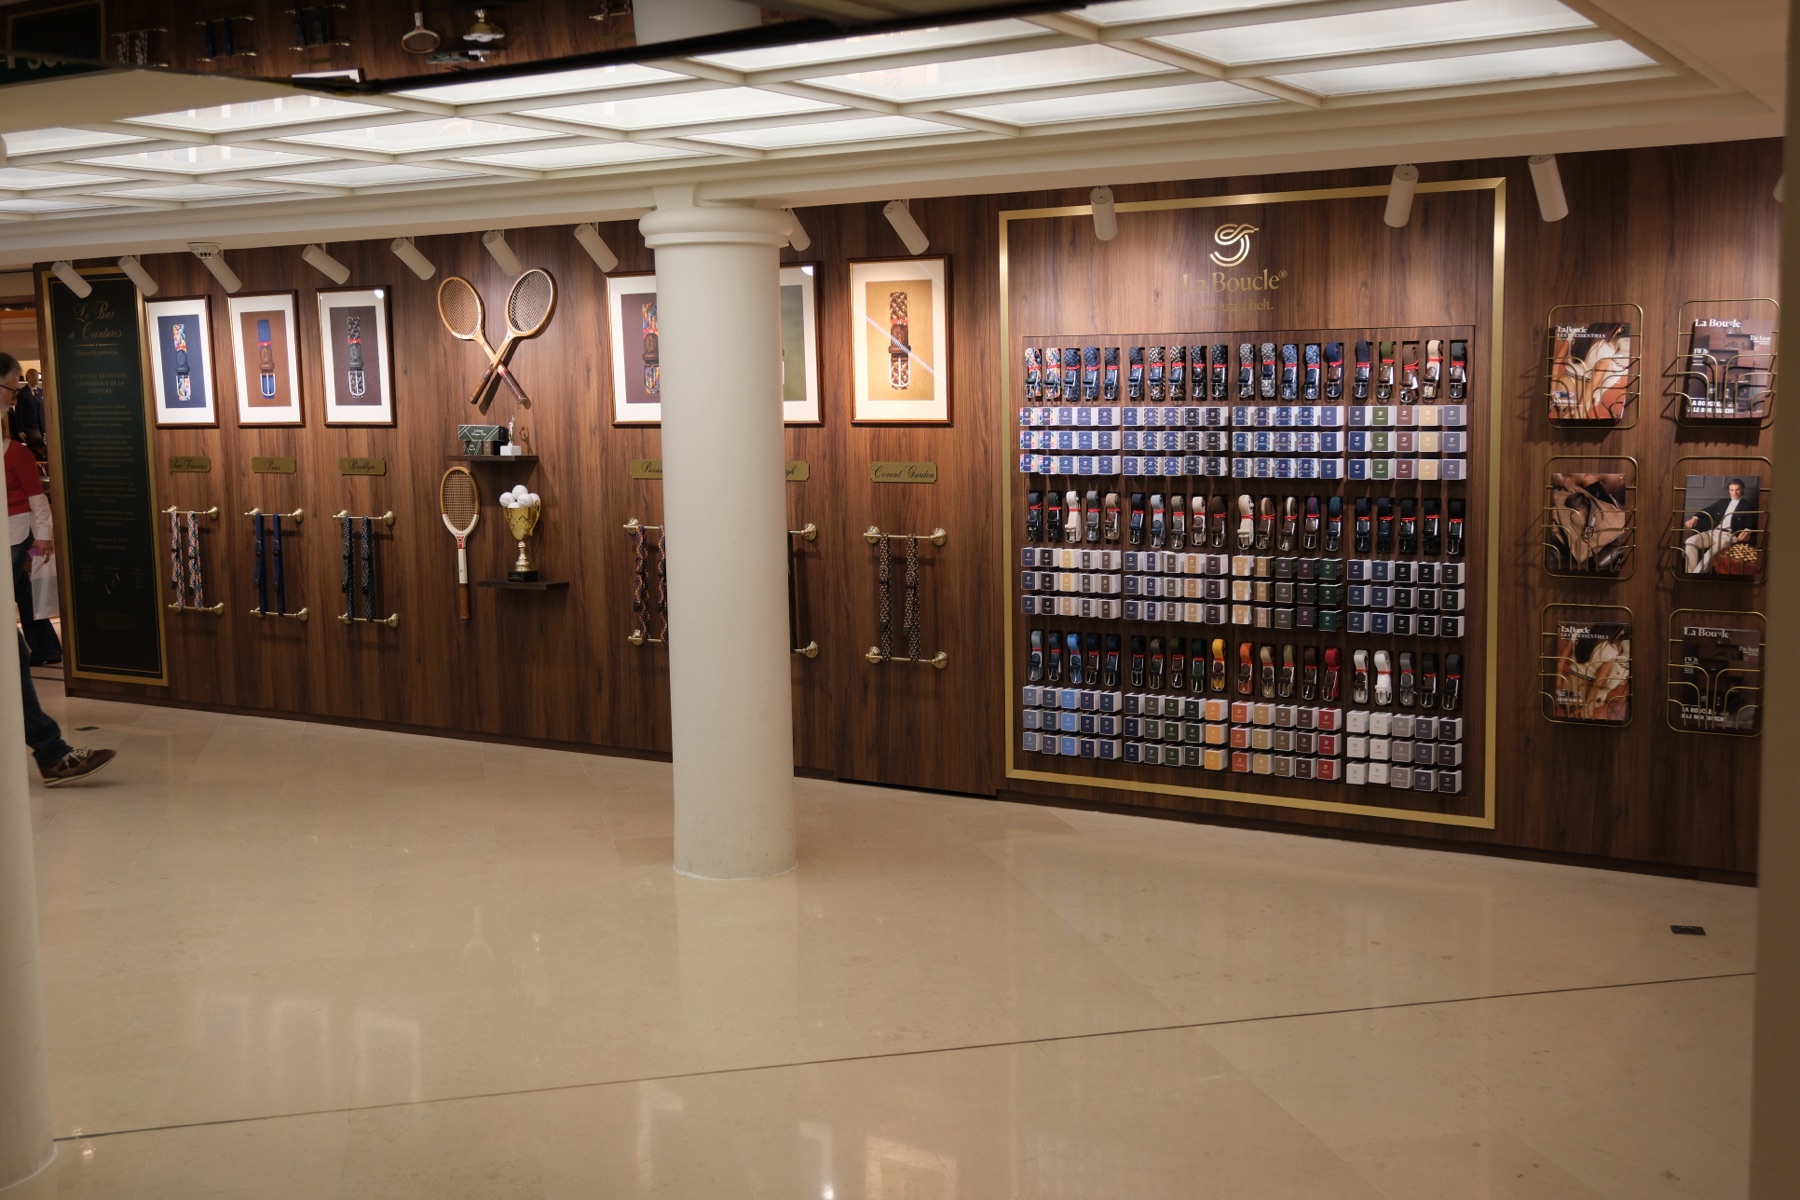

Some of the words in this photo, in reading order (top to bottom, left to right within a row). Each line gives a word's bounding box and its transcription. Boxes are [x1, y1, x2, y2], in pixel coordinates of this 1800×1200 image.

[1183, 274, 1207, 294] La
[1250, 298, 1274, 311] belt.
[73, 303, 89, 322] Le
[94, 301, 115, 319] Bar
[1694, 318, 1707, 327] La
[80, 321, 123, 339] Ceintures
[265, 459, 281, 471] Paris
[348, 458, 375, 473] Brooklyn
[641, 460, 663, 473] Picca
[871, 464, 903, 478] Covent
[903, 464, 935, 479] Garden
[1683, 627, 1697, 636] La
[1690, 707, 1712, 715] BOUCE
